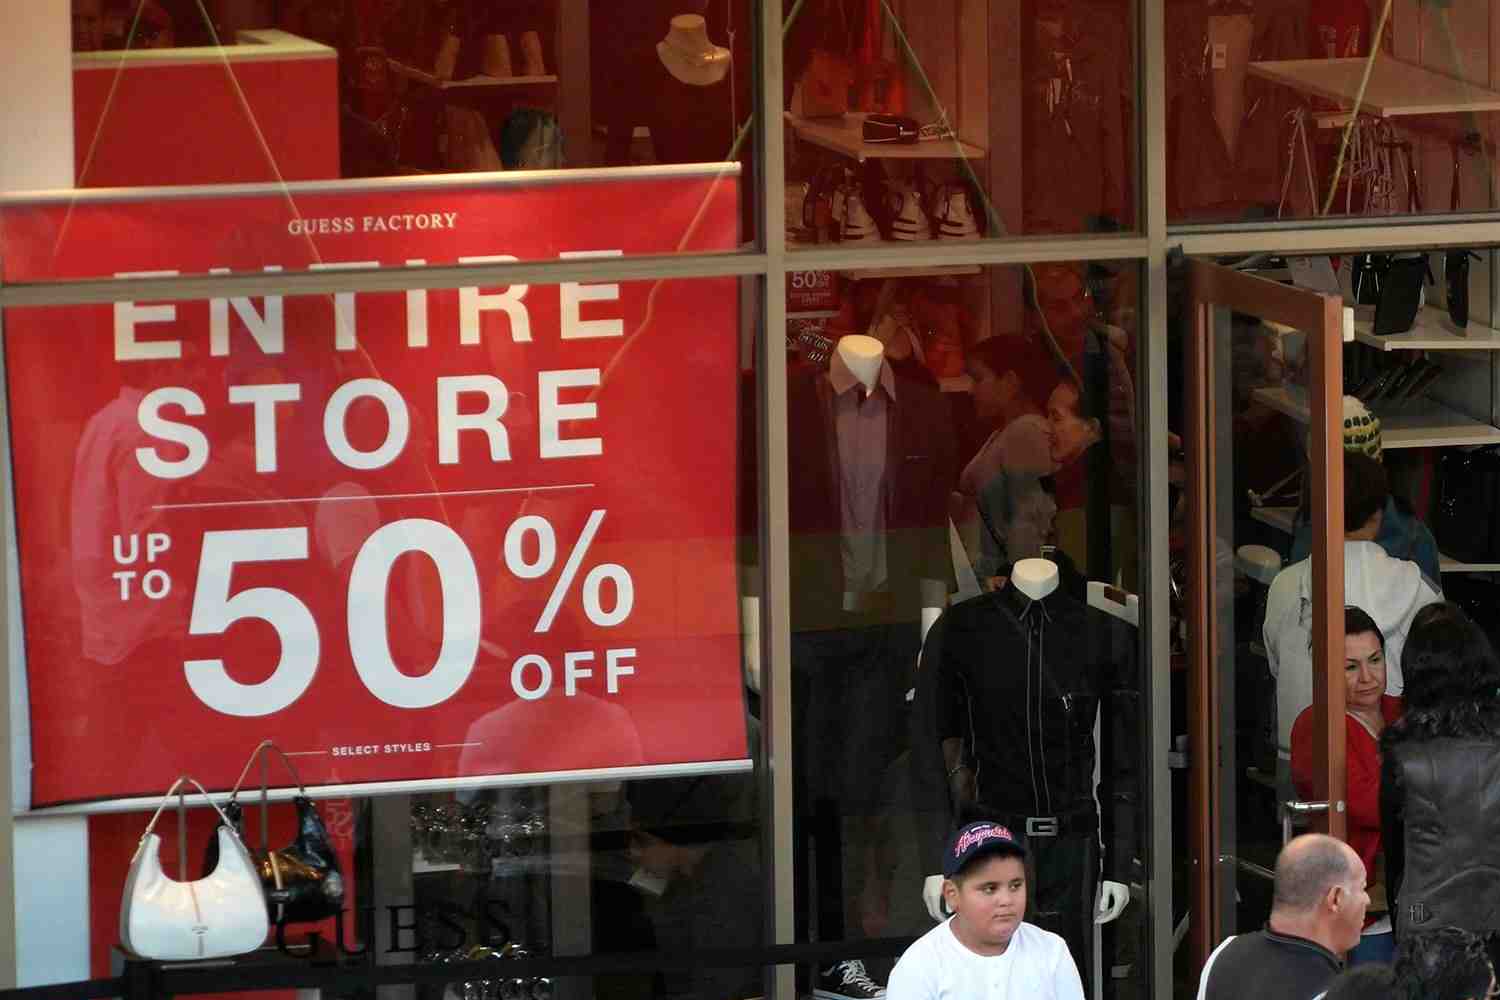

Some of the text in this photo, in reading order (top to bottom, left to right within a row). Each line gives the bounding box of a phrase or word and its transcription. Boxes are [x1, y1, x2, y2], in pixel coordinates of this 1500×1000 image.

[287, 212, 457, 235] GUESS FACTORY
[114, 249, 625, 362] ENTIRE
[135, 368, 604, 480] STORE
[112, 532, 171, 565] UP
[112, 570, 172, 601] TO
[184, 509, 636, 717] 50%
[510, 647, 636, 701] OFF
[331, 742, 432, 756] SELECT STYLES
